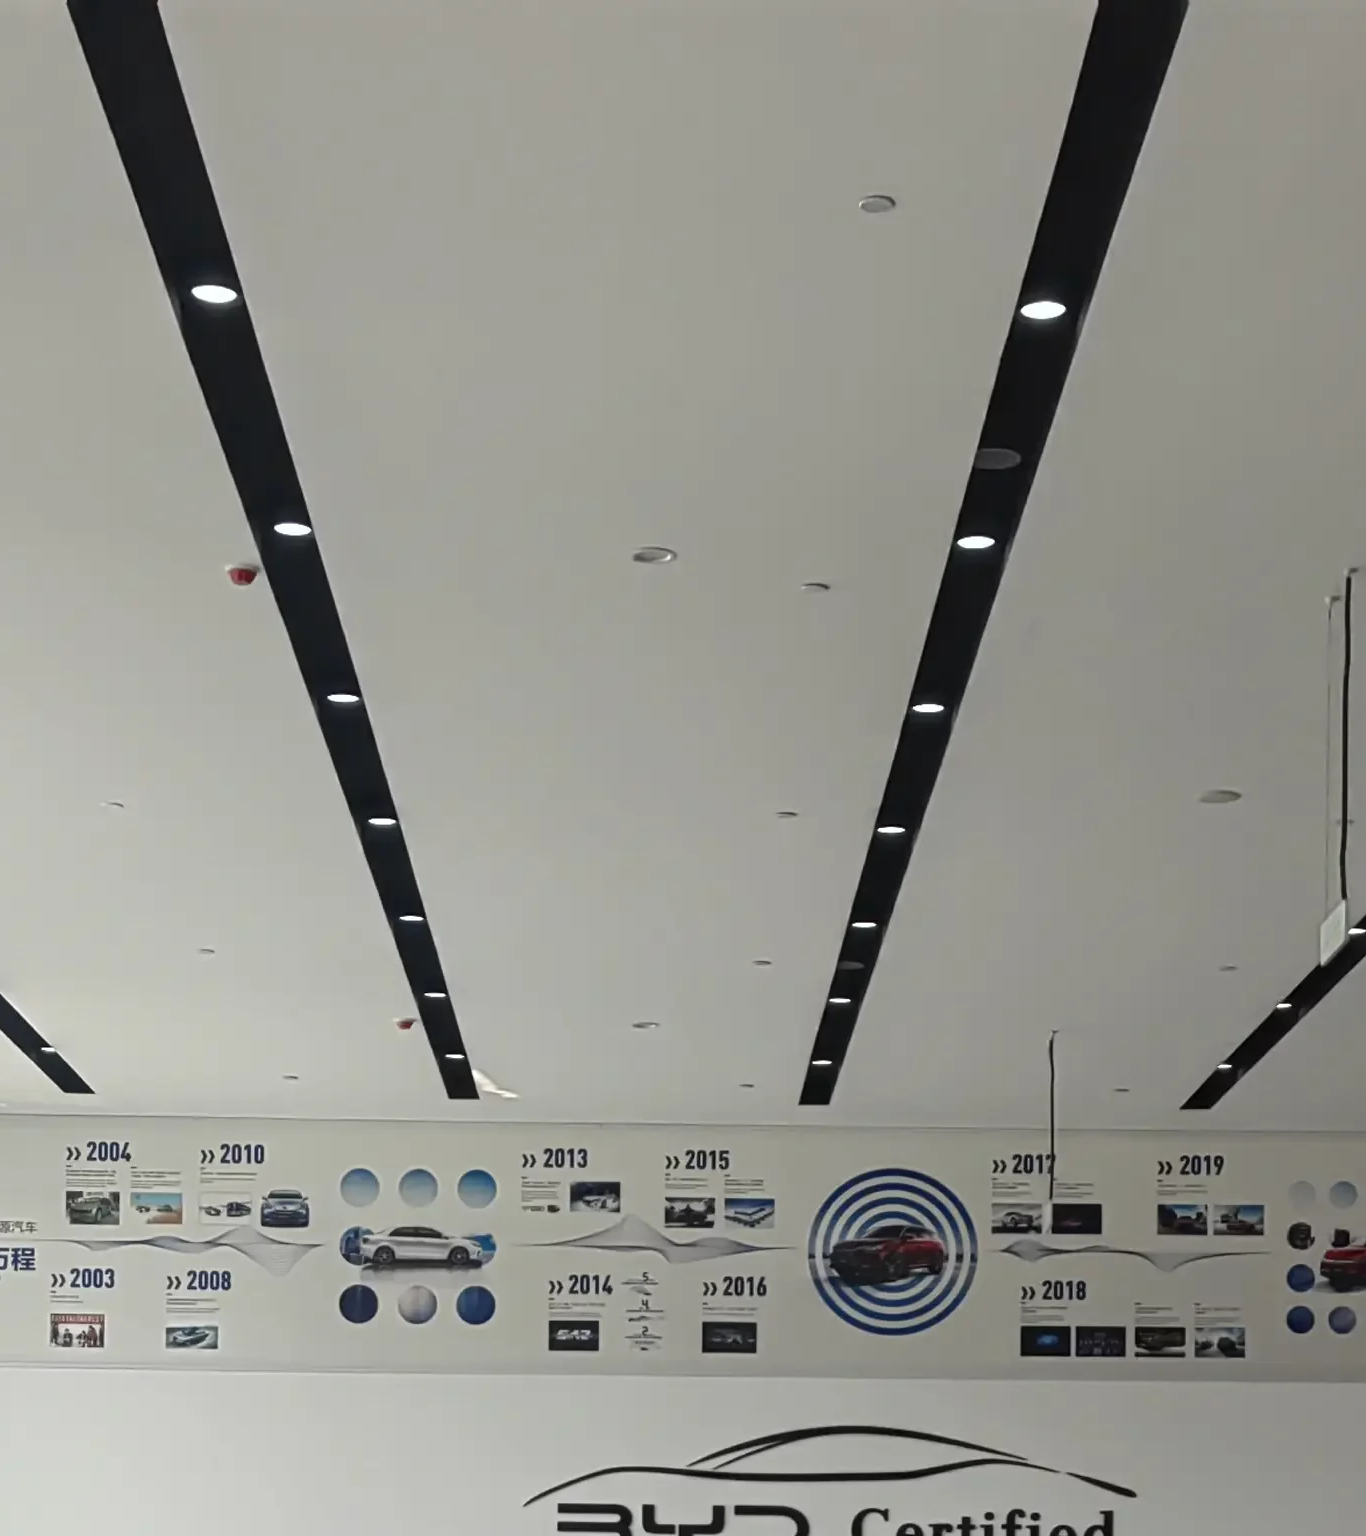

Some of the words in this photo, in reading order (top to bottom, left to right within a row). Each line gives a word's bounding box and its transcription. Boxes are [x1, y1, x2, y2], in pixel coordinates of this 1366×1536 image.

[87, 1141, 132, 1162] 2004
[220, 1143, 265, 1165] 2010
[543, 1147, 588, 1169] 2013
[685, 1149, 730, 1171] 2015
[1012, 1153, 1057, 1175] 2017
[1179, 1154, 1225, 1176] 2019
[70, 1267, 115, 1289] 2003
[186, 1270, 232, 1291] 2008
[568, 1274, 614, 1295] 2014
[722, 1275, 767, 1297] 2016
[1042, 1279, 1087, 1301] 2018
